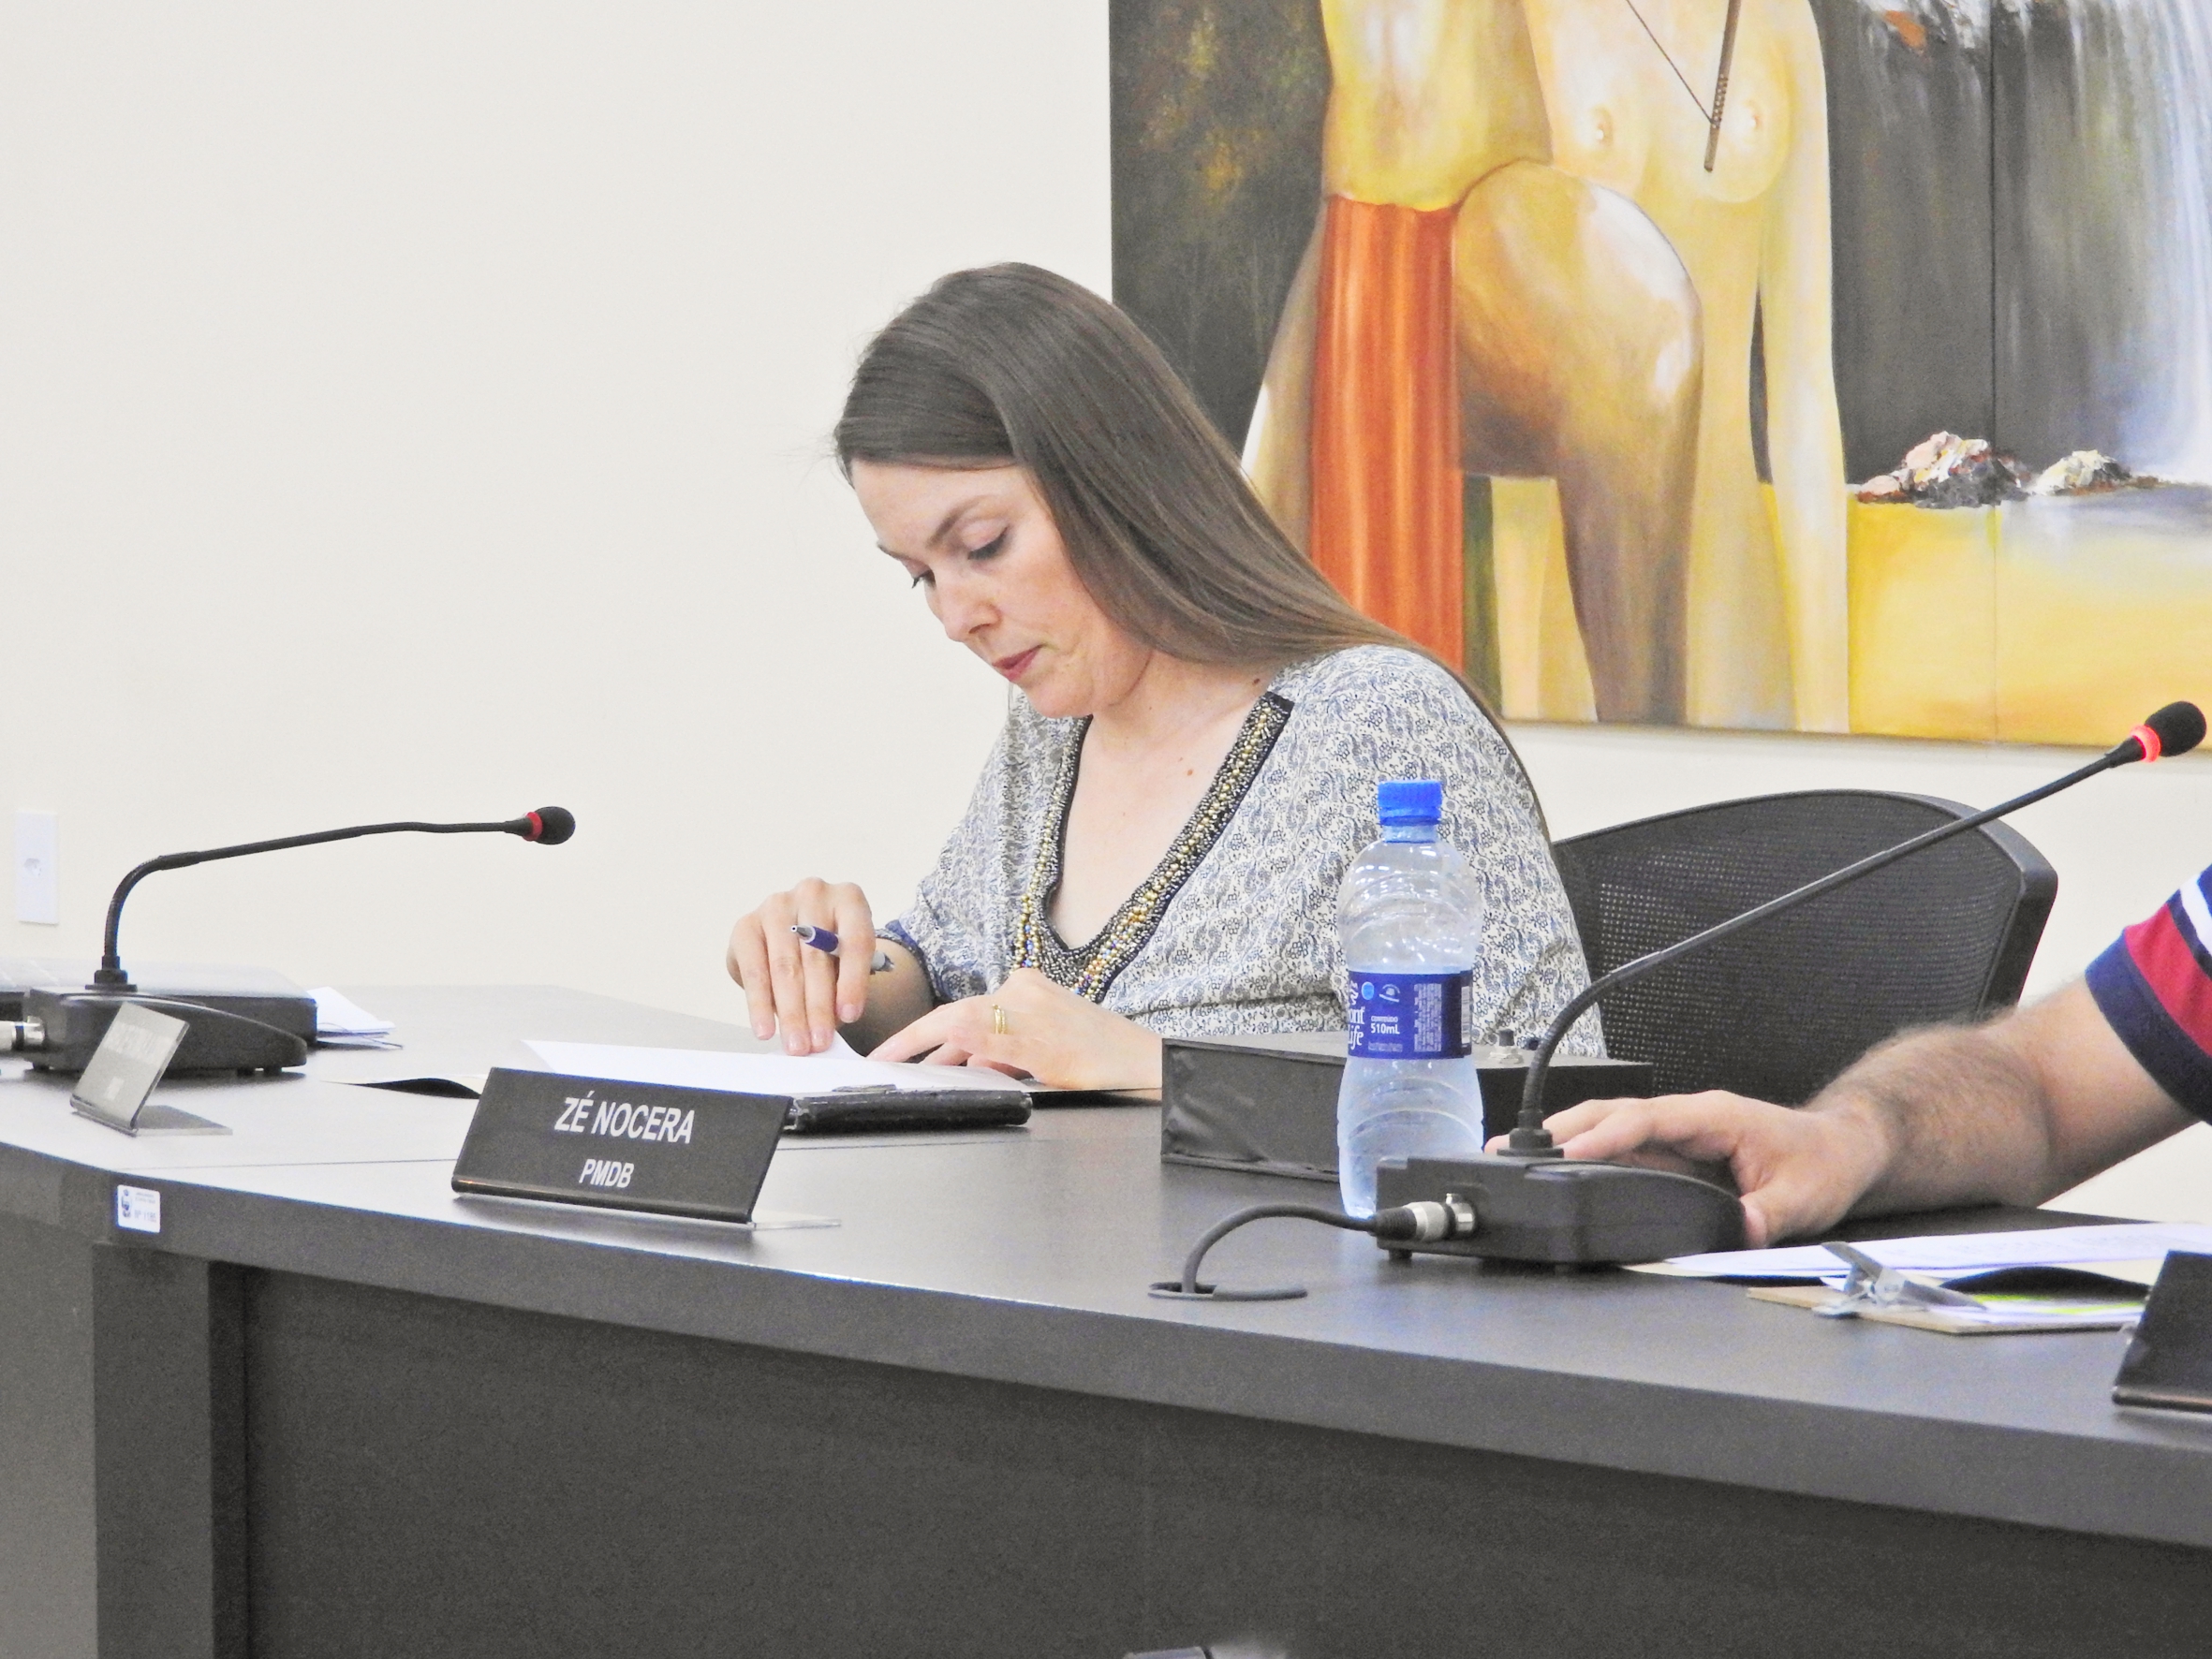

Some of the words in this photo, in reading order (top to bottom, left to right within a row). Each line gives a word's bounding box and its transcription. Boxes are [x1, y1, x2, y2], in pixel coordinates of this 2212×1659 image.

[1371, 1022, 1400, 1035] 510mL
[554, 1090, 595, 1133] ZÉ
[591, 1100, 695, 1144] NOCERA
[579, 1158, 634, 1188] PMDB
